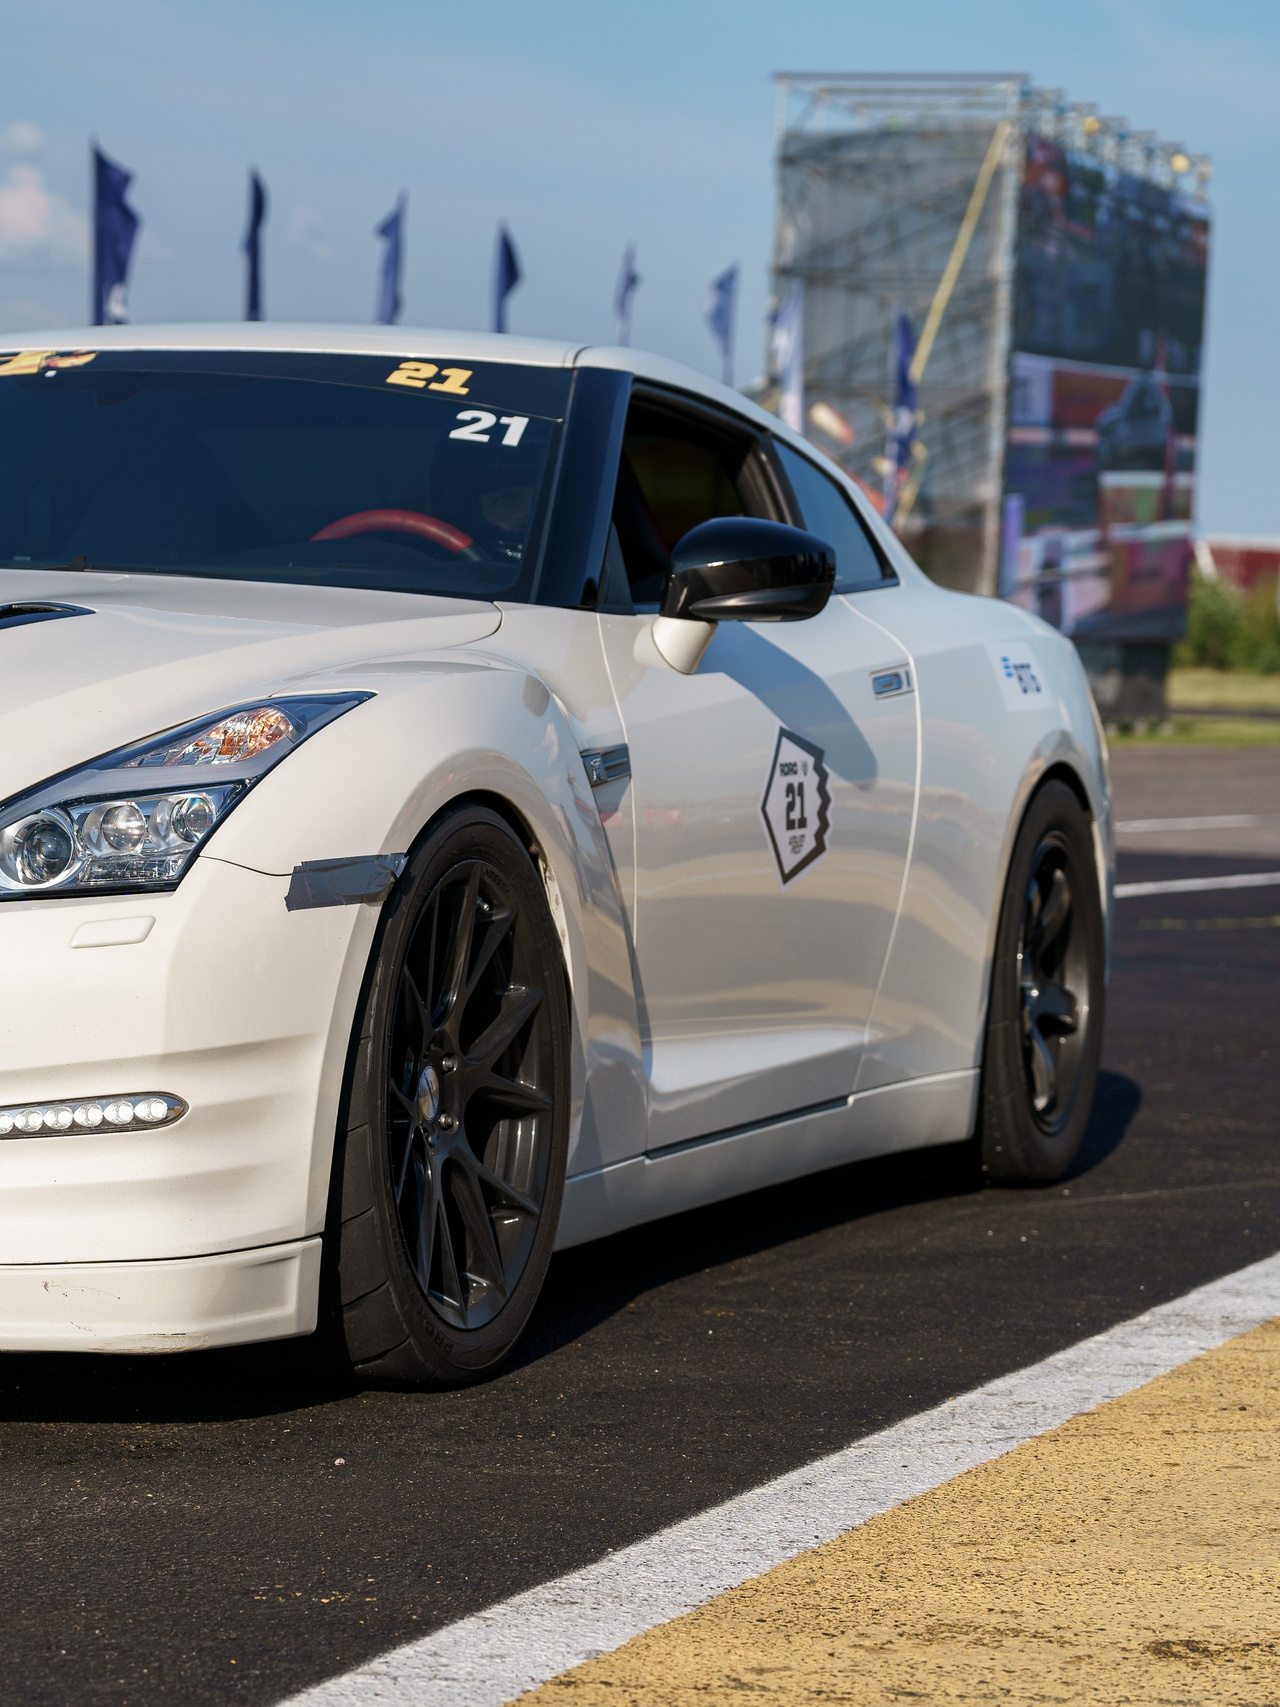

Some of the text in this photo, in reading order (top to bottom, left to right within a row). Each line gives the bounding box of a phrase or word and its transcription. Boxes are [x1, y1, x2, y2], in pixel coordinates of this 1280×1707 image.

[385, 361, 473, 395] 21
[448, 410, 529, 447] 21
[785, 781, 807, 830] 21
